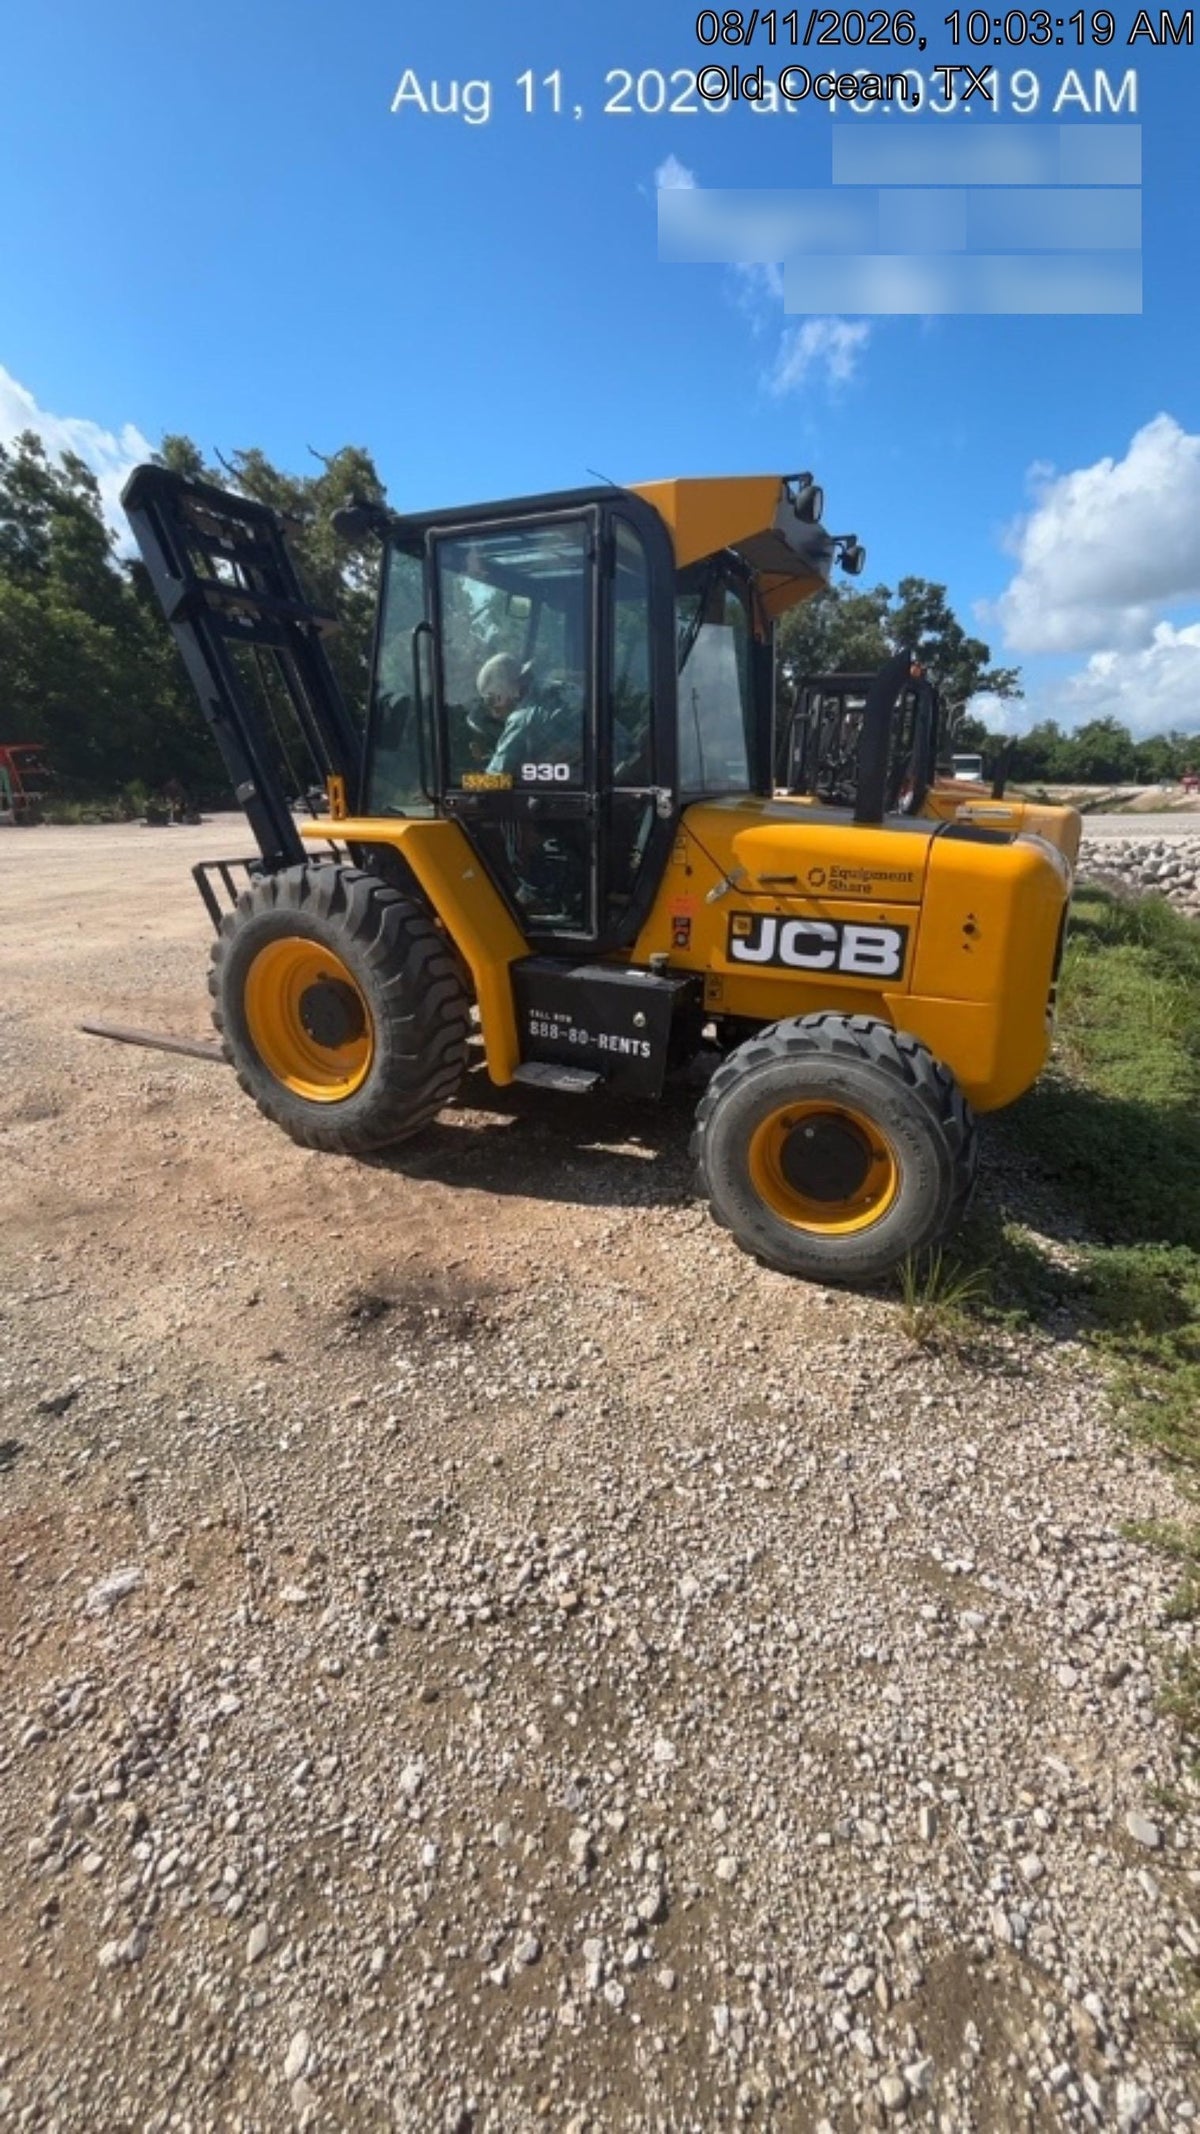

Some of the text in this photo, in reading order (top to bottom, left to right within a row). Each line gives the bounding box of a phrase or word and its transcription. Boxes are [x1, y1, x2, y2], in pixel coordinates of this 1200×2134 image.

[521, 763, 571, 781] 930
[829, 866, 914, 883] Equipment
[827, 879, 873, 894] Share
[732, 917, 901, 976] JCB
[529, 1020, 651, 1058] 888-80-RENTS
